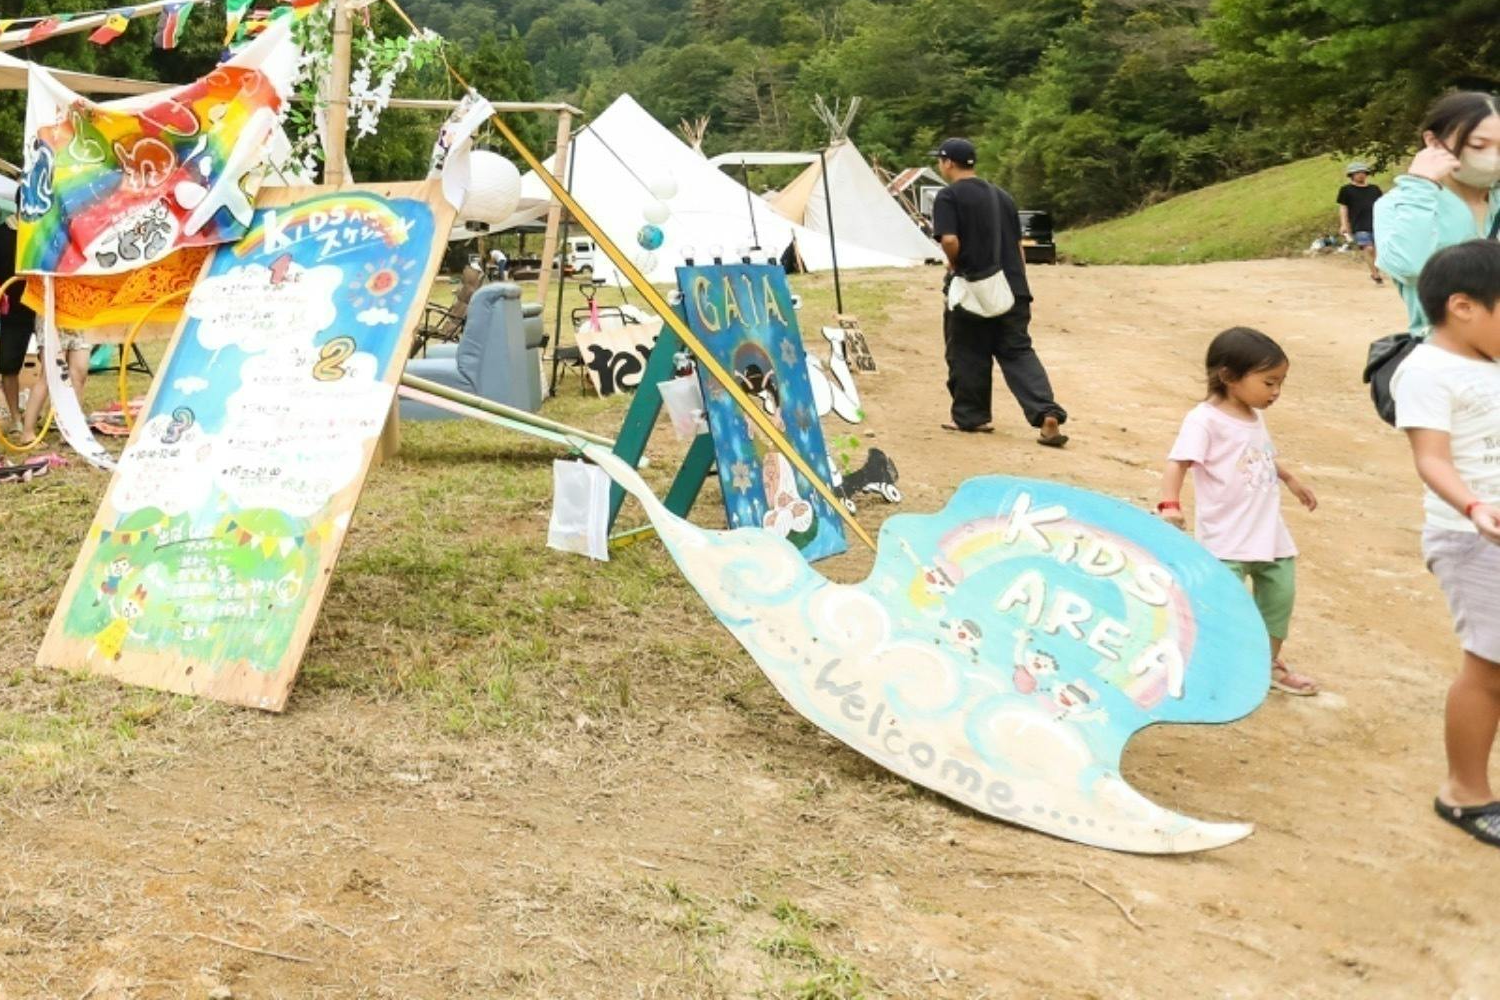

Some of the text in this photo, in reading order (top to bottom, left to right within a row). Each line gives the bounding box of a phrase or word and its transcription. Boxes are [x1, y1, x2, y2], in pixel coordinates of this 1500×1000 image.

[694, 274, 789, 332] GAIA
[312, 336, 357, 382] 2
[998, 568, 1186, 699] AREA
